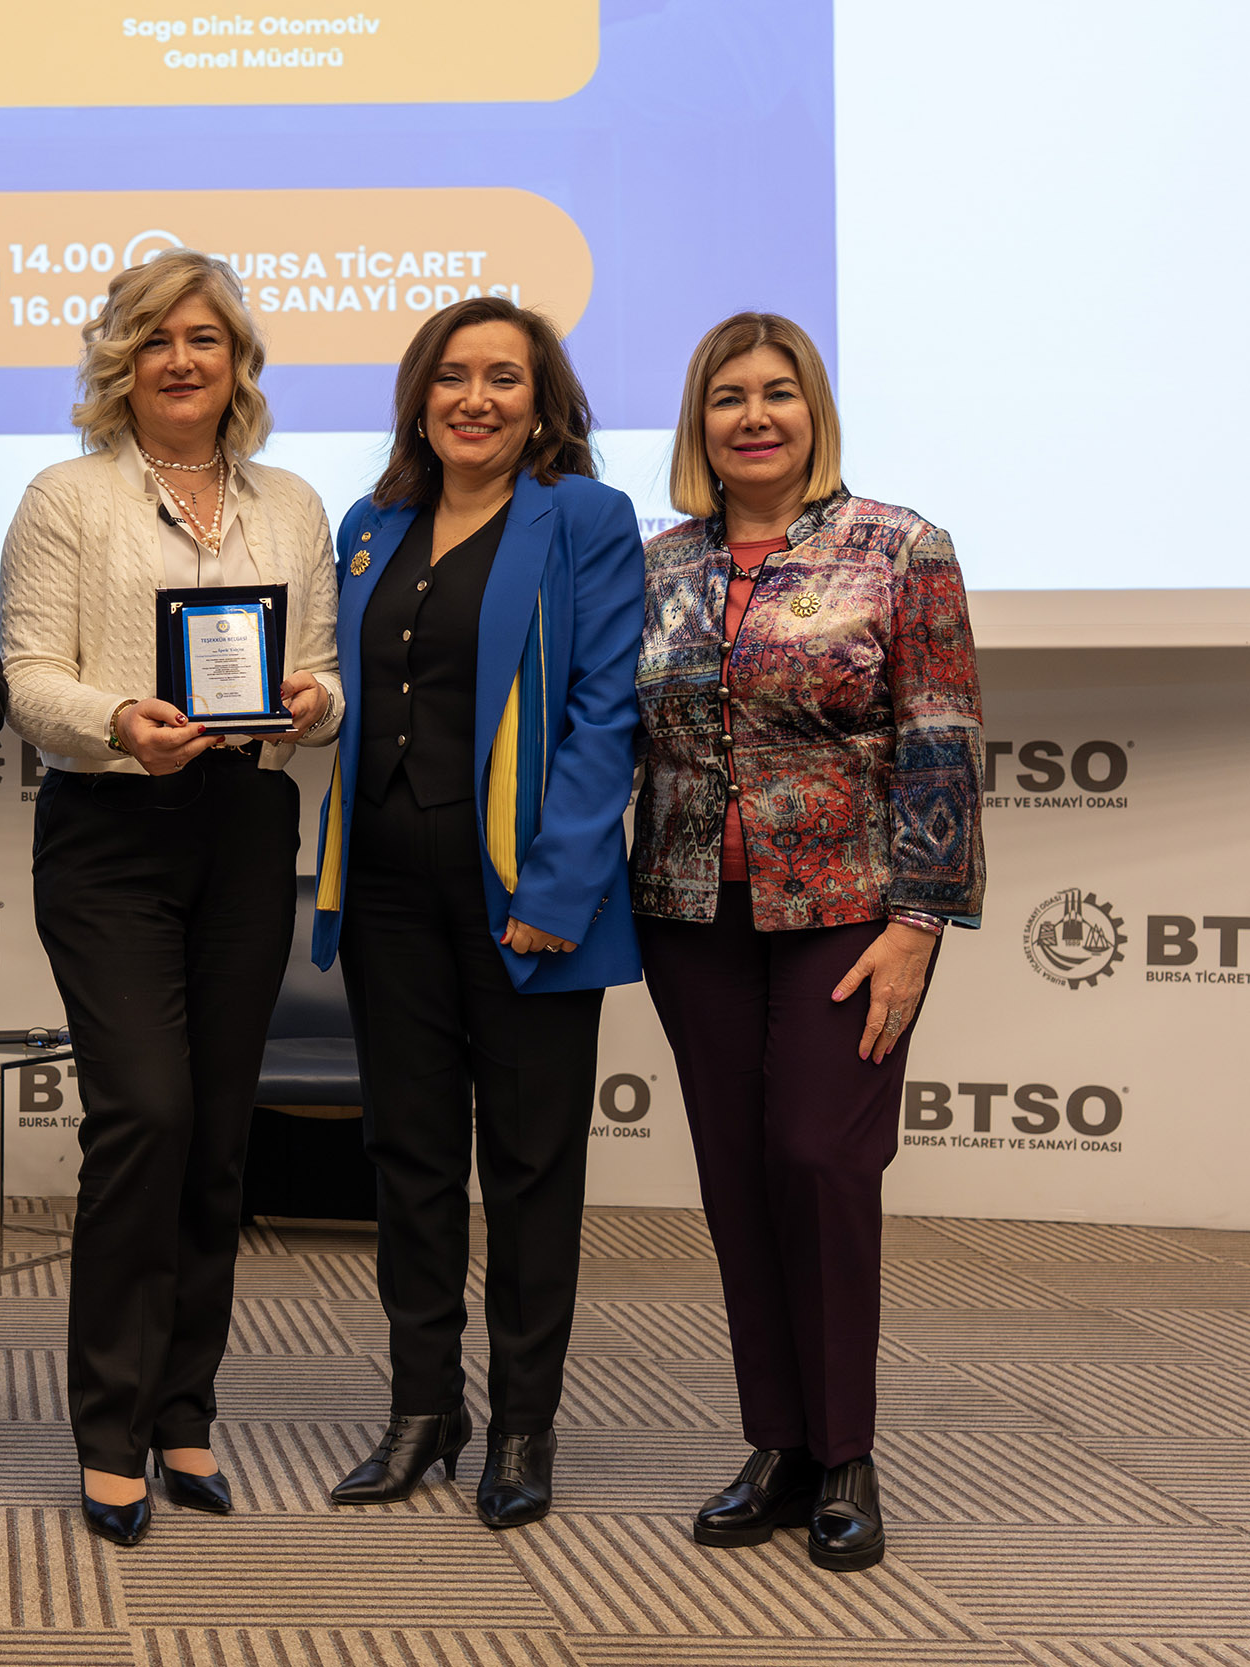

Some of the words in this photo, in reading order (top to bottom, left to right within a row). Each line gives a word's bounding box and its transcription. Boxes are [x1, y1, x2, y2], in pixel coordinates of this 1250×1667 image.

[122, 18, 187, 42] Sage
[192, 15, 254, 36] Diniz
[259, 14, 380, 35] Otomotiv
[164, 49, 237, 68] Genel
[243, 48, 344, 68] Müdürü
[9, 242, 115, 274] 14.00
[335, 245, 487, 279] TİCARET
[259, 278, 397, 313] SANAYİ
[984, 740, 1128, 792] TSO
[1014, 797, 1031, 808] VE
[1034, 795, 1083, 808] SANAYİ
[1086, 797, 1128, 808] ODASI
[1146, 915, 1250, 967] BT
[1146, 971, 1191, 983] BURSA
[19, 1117, 58, 1128] BURSA
[904, 1081, 1123, 1137] BTSO
[589, 1125, 609, 1137] AYİ
[612, 1127, 651, 1138] ODASI
[903, 1135, 947, 1147] BURSA
[951, 1134, 1005, 1149] TİCARET
[1009, 1139, 1025, 1149] VE
[1029, 1138, 1077, 1151] SANAYİ
[1081, 1141, 1122, 1152] ODASI
